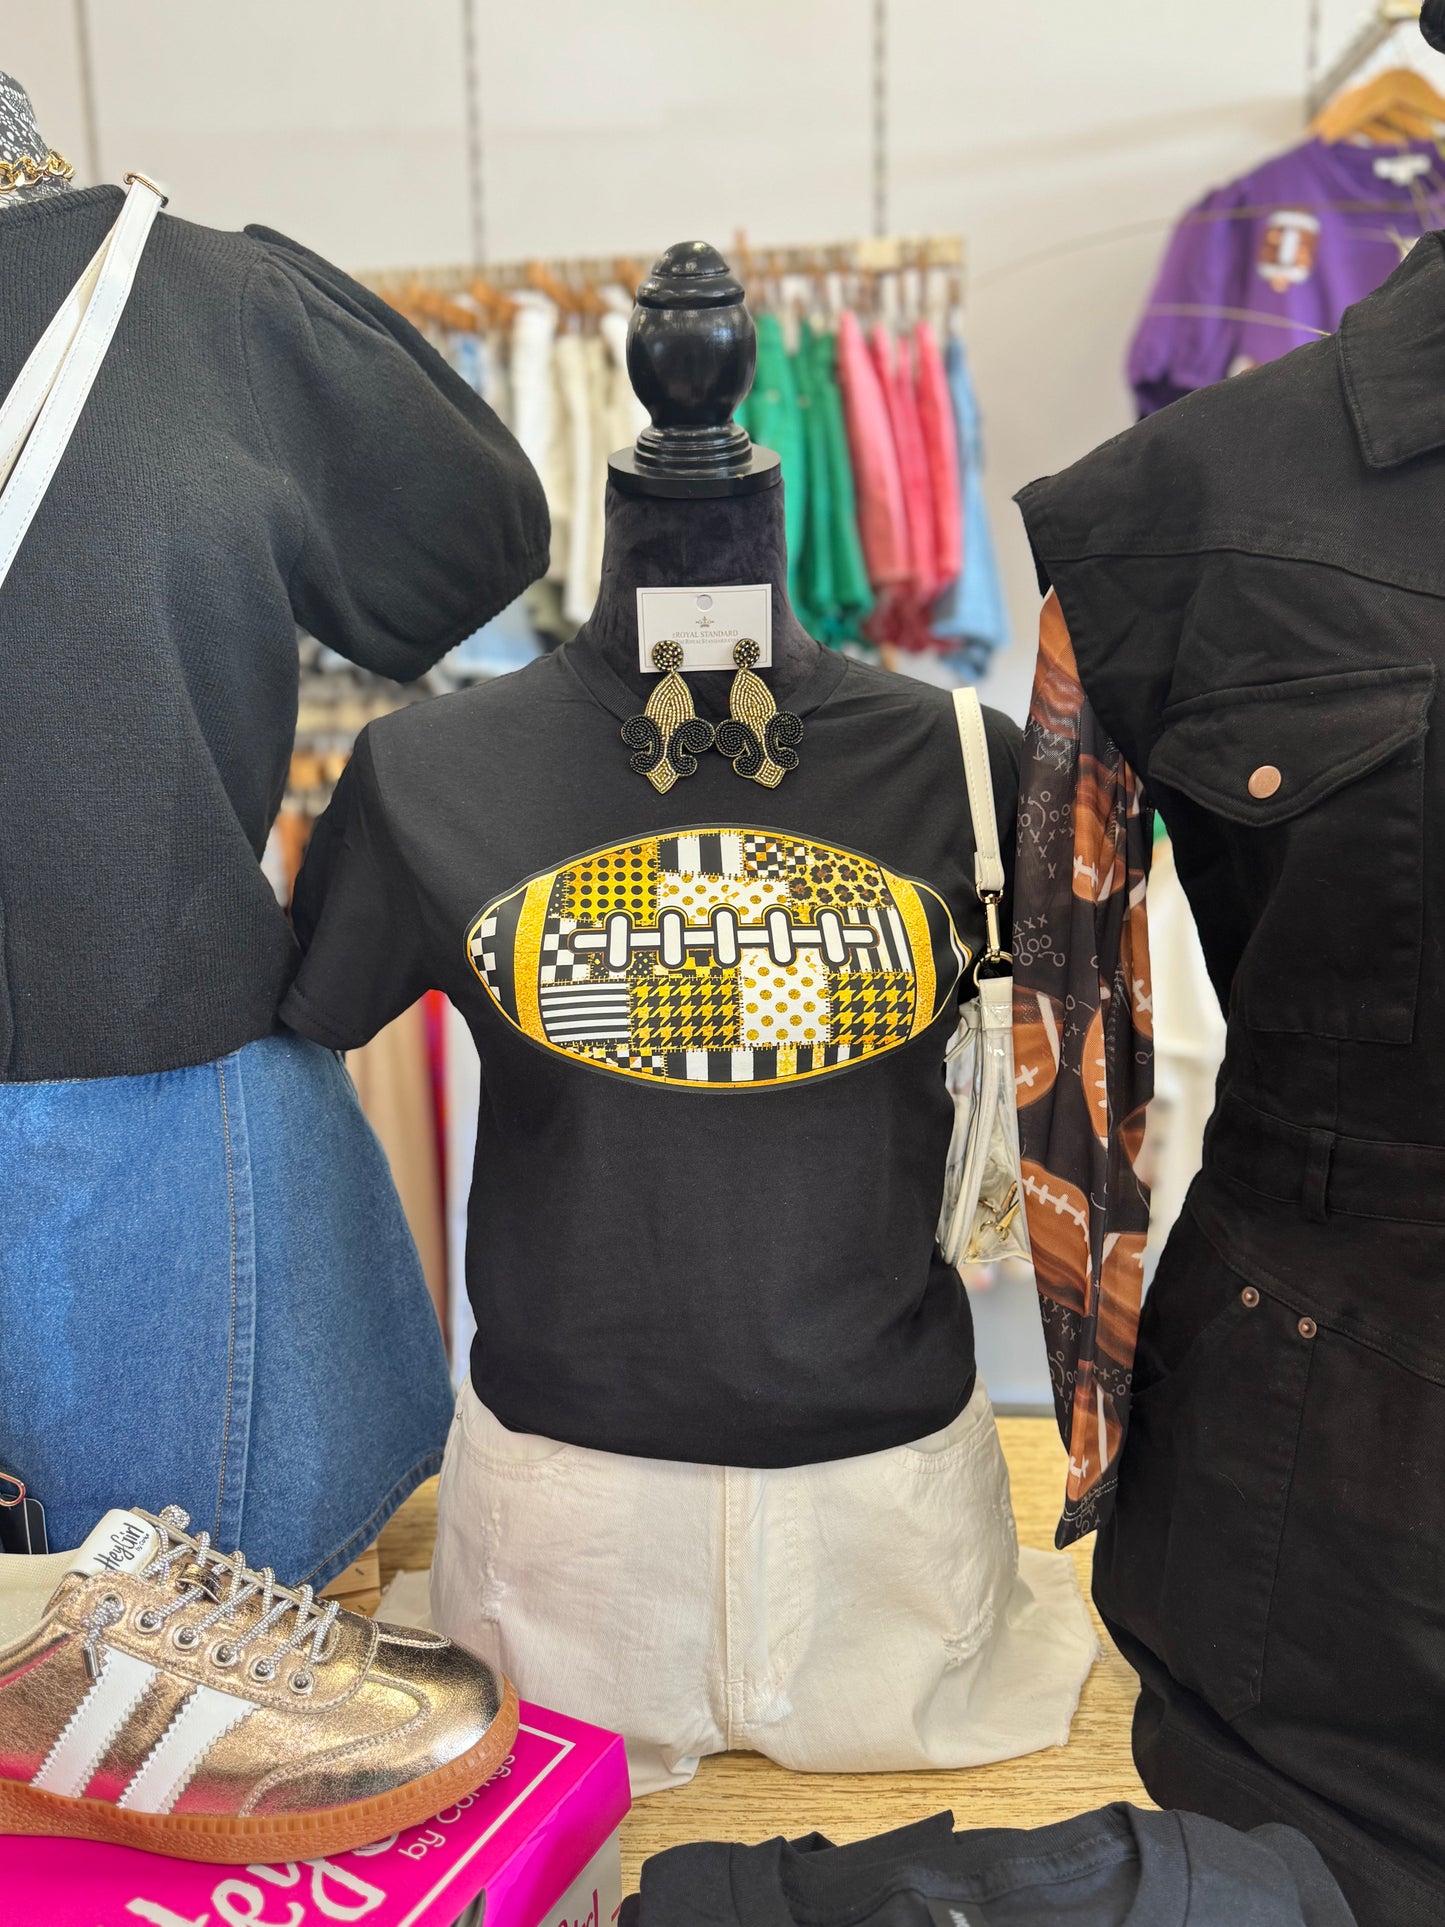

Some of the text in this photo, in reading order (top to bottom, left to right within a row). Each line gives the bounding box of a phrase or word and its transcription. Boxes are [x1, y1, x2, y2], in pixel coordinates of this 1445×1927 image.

[700, 630, 738, 638] STANDARD
[398, 1754, 516, 1860] by Coys
